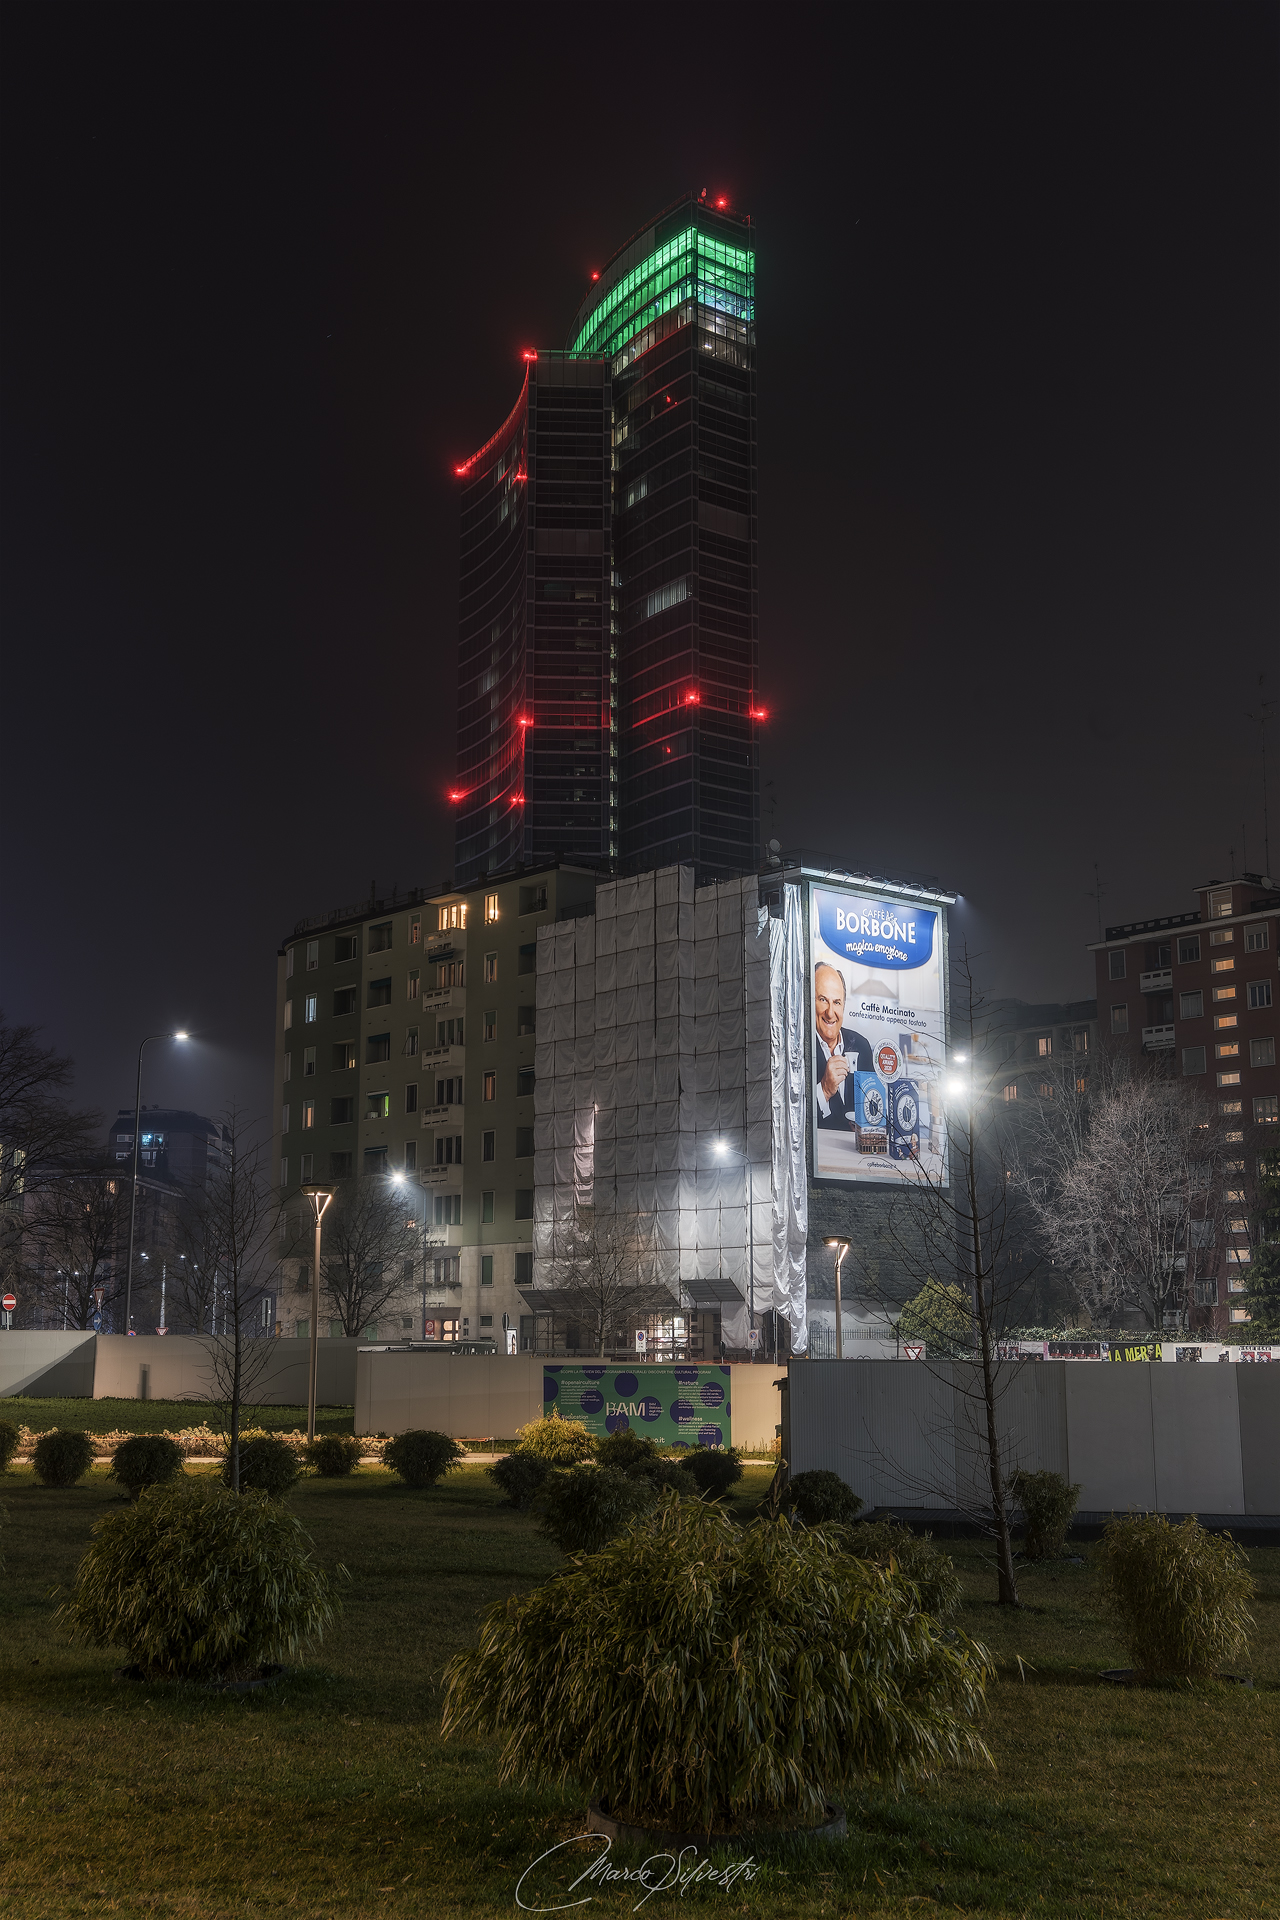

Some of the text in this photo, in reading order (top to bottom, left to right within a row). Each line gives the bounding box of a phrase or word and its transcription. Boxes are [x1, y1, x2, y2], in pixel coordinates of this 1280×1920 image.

[862, 908, 885, 921] CAFFÈ
[836, 907, 916, 944] BORBONE
[846, 939, 909, 962] magica emozione
[861, 1002, 916, 1018] Caffè Macinato
[848, 1011, 927, 1028] confezionato appena tostato
[1125, 1344, 1163, 1362] MERA
[606, 1402, 646, 1417] BAM
